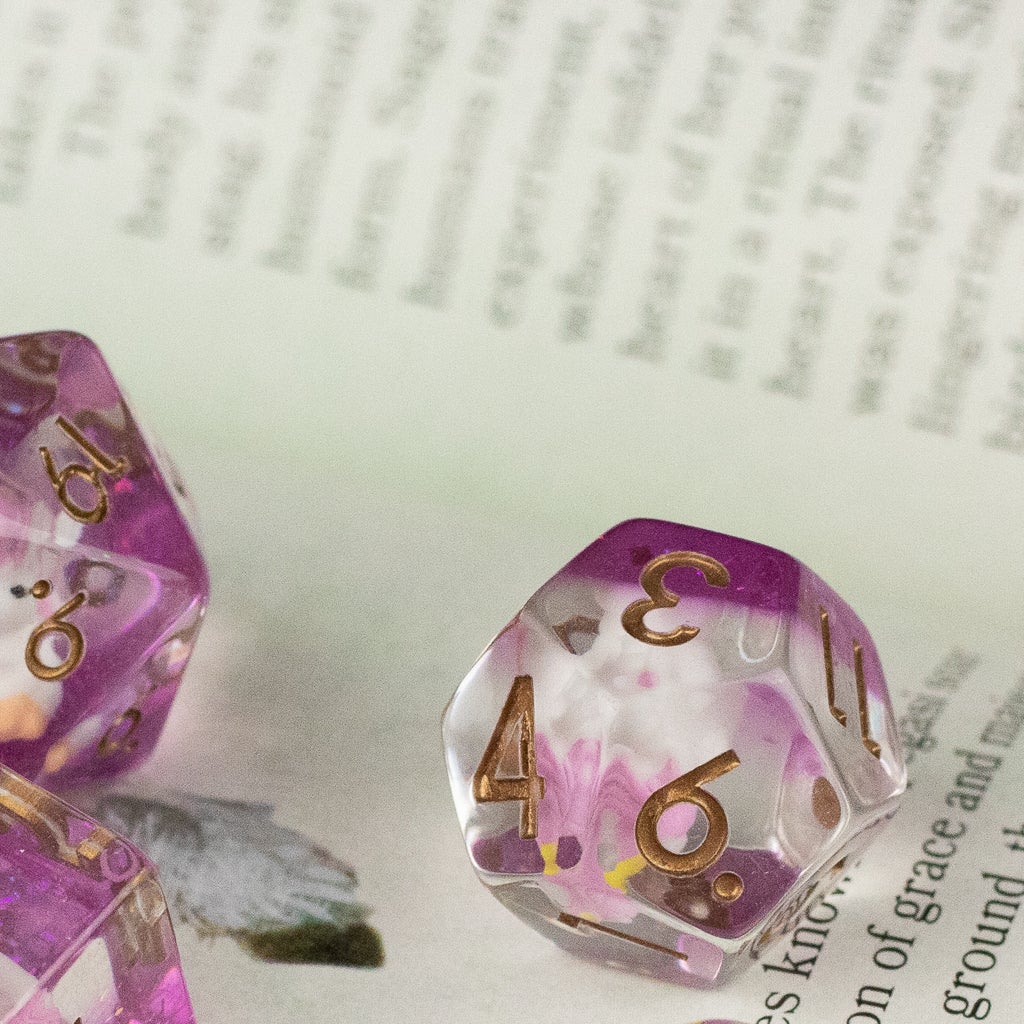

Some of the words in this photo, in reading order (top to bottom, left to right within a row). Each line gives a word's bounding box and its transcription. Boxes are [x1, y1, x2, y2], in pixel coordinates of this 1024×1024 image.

[472, 674, 545, 840] 4
[867, 923, 915, 971] of
[894, 816, 967, 925] grace
[944, 748, 1003, 812] and
